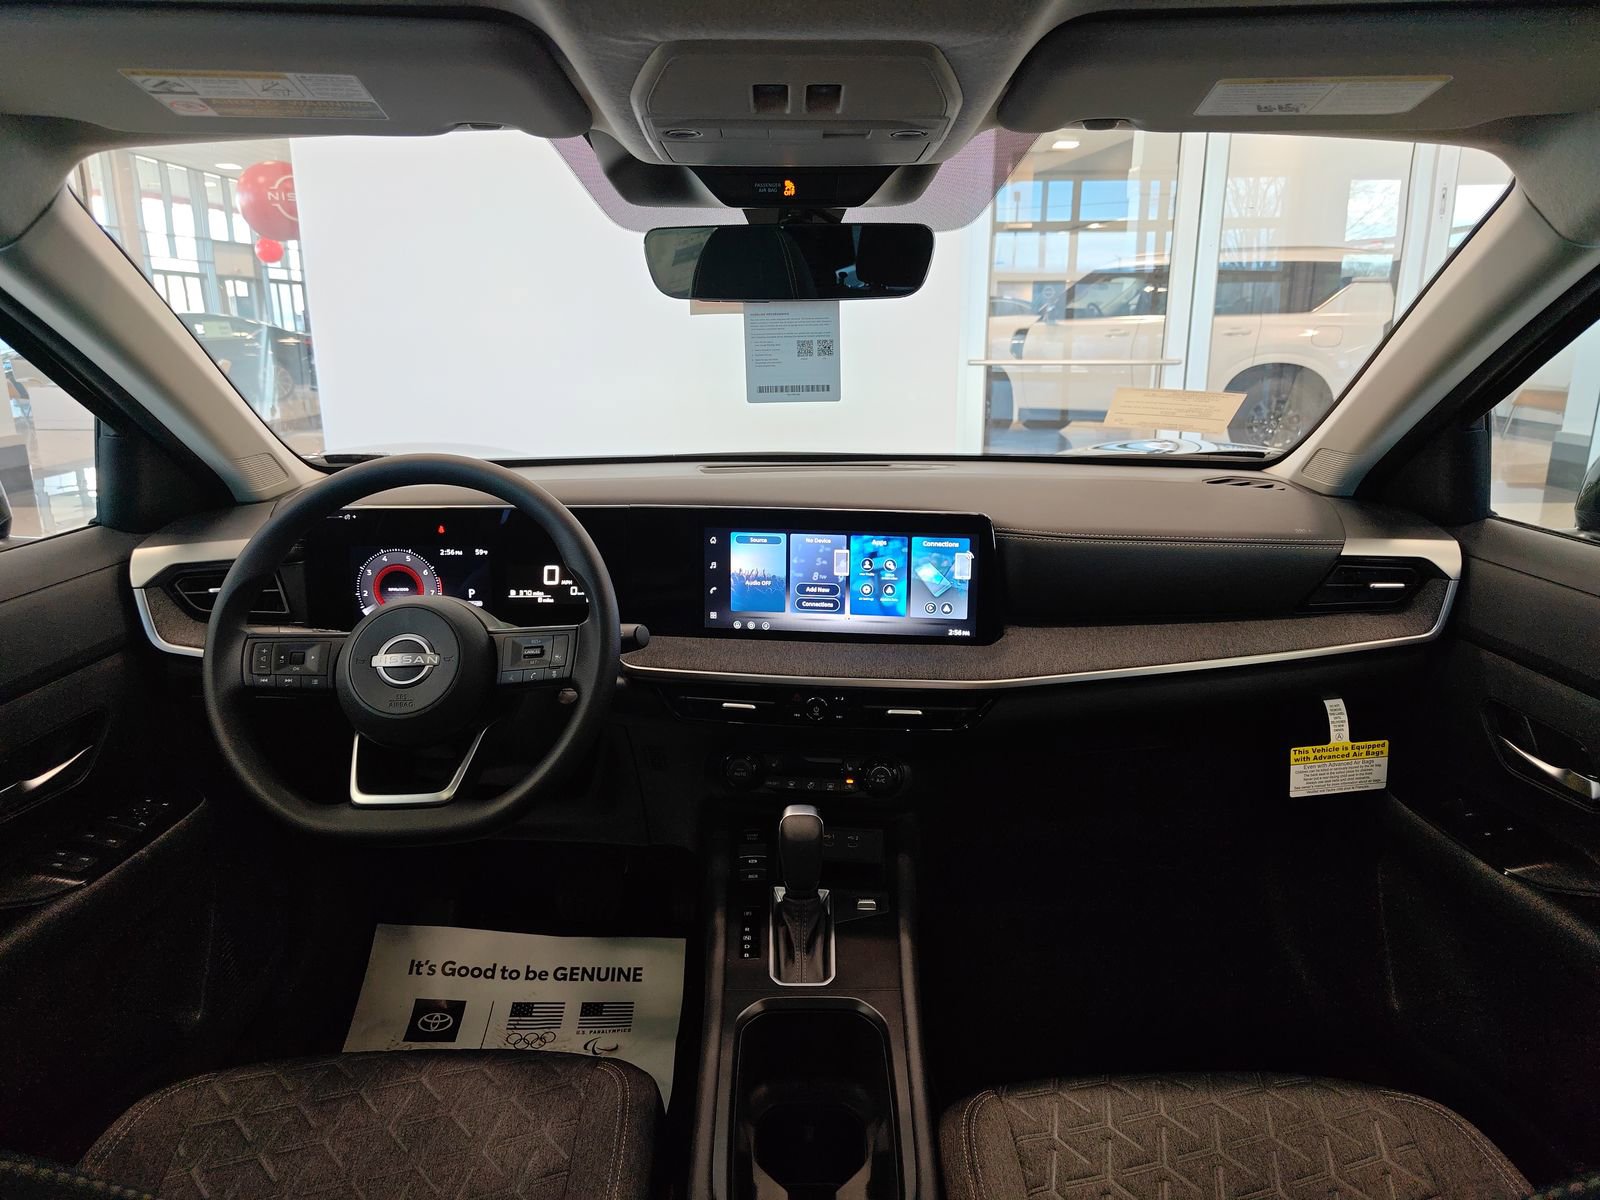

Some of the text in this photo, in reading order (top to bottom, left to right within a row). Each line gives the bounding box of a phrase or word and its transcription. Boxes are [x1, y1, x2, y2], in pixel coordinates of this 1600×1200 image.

[871, 539, 888, 547] Apps
[923, 541, 960, 549] Connections
[544, 565, 560, 586] 0
[468, 588, 476, 598] P
[802, 600, 834, 608] Connections
[374, 655, 438, 666] NISSAN
[1312, 746, 1340, 754] Vehicle
[1351, 742, 1386, 750] Equipped
[1312, 752, 1350, 761] Advanced
[408, 959, 643, 982] It's Good to be GENUINE
